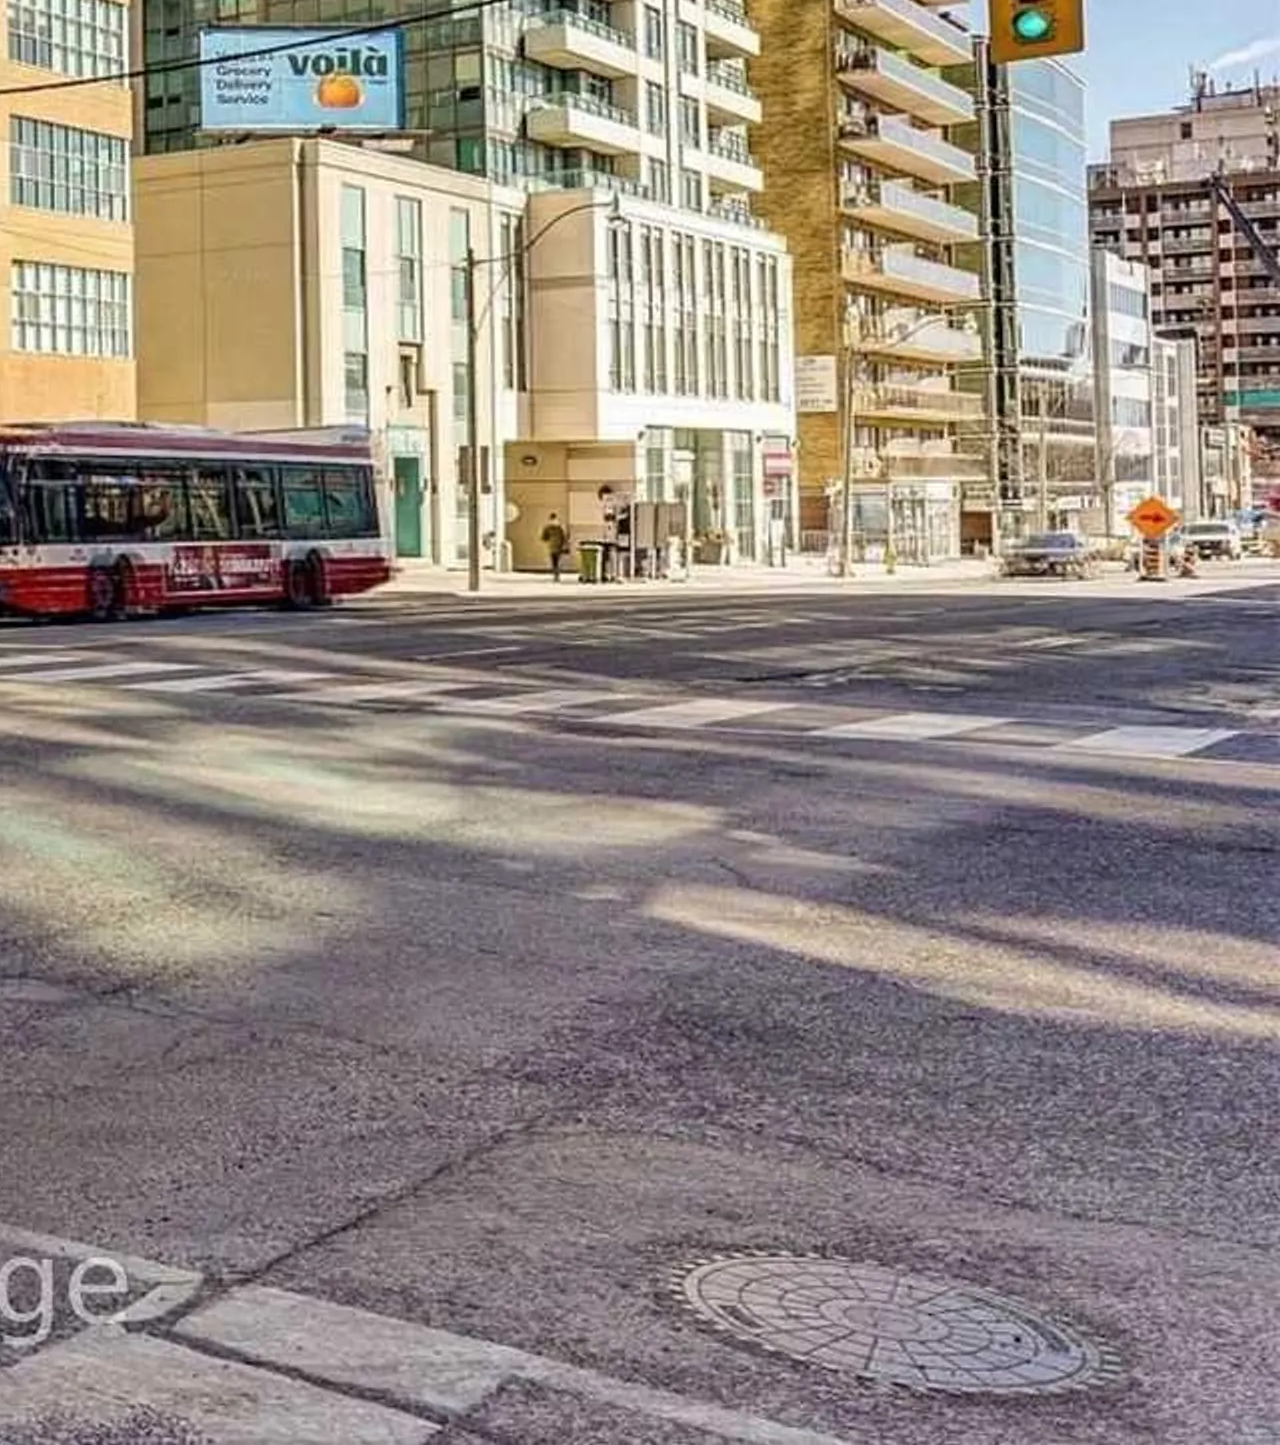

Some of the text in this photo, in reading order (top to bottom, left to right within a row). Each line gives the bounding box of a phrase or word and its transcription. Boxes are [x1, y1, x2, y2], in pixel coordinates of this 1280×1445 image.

[289, 46, 388, 76] voilà
[216, 65, 271, 77] Grocery
[216, 79, 271, 91] Delivery
[216, 93, 269, 104] Service
